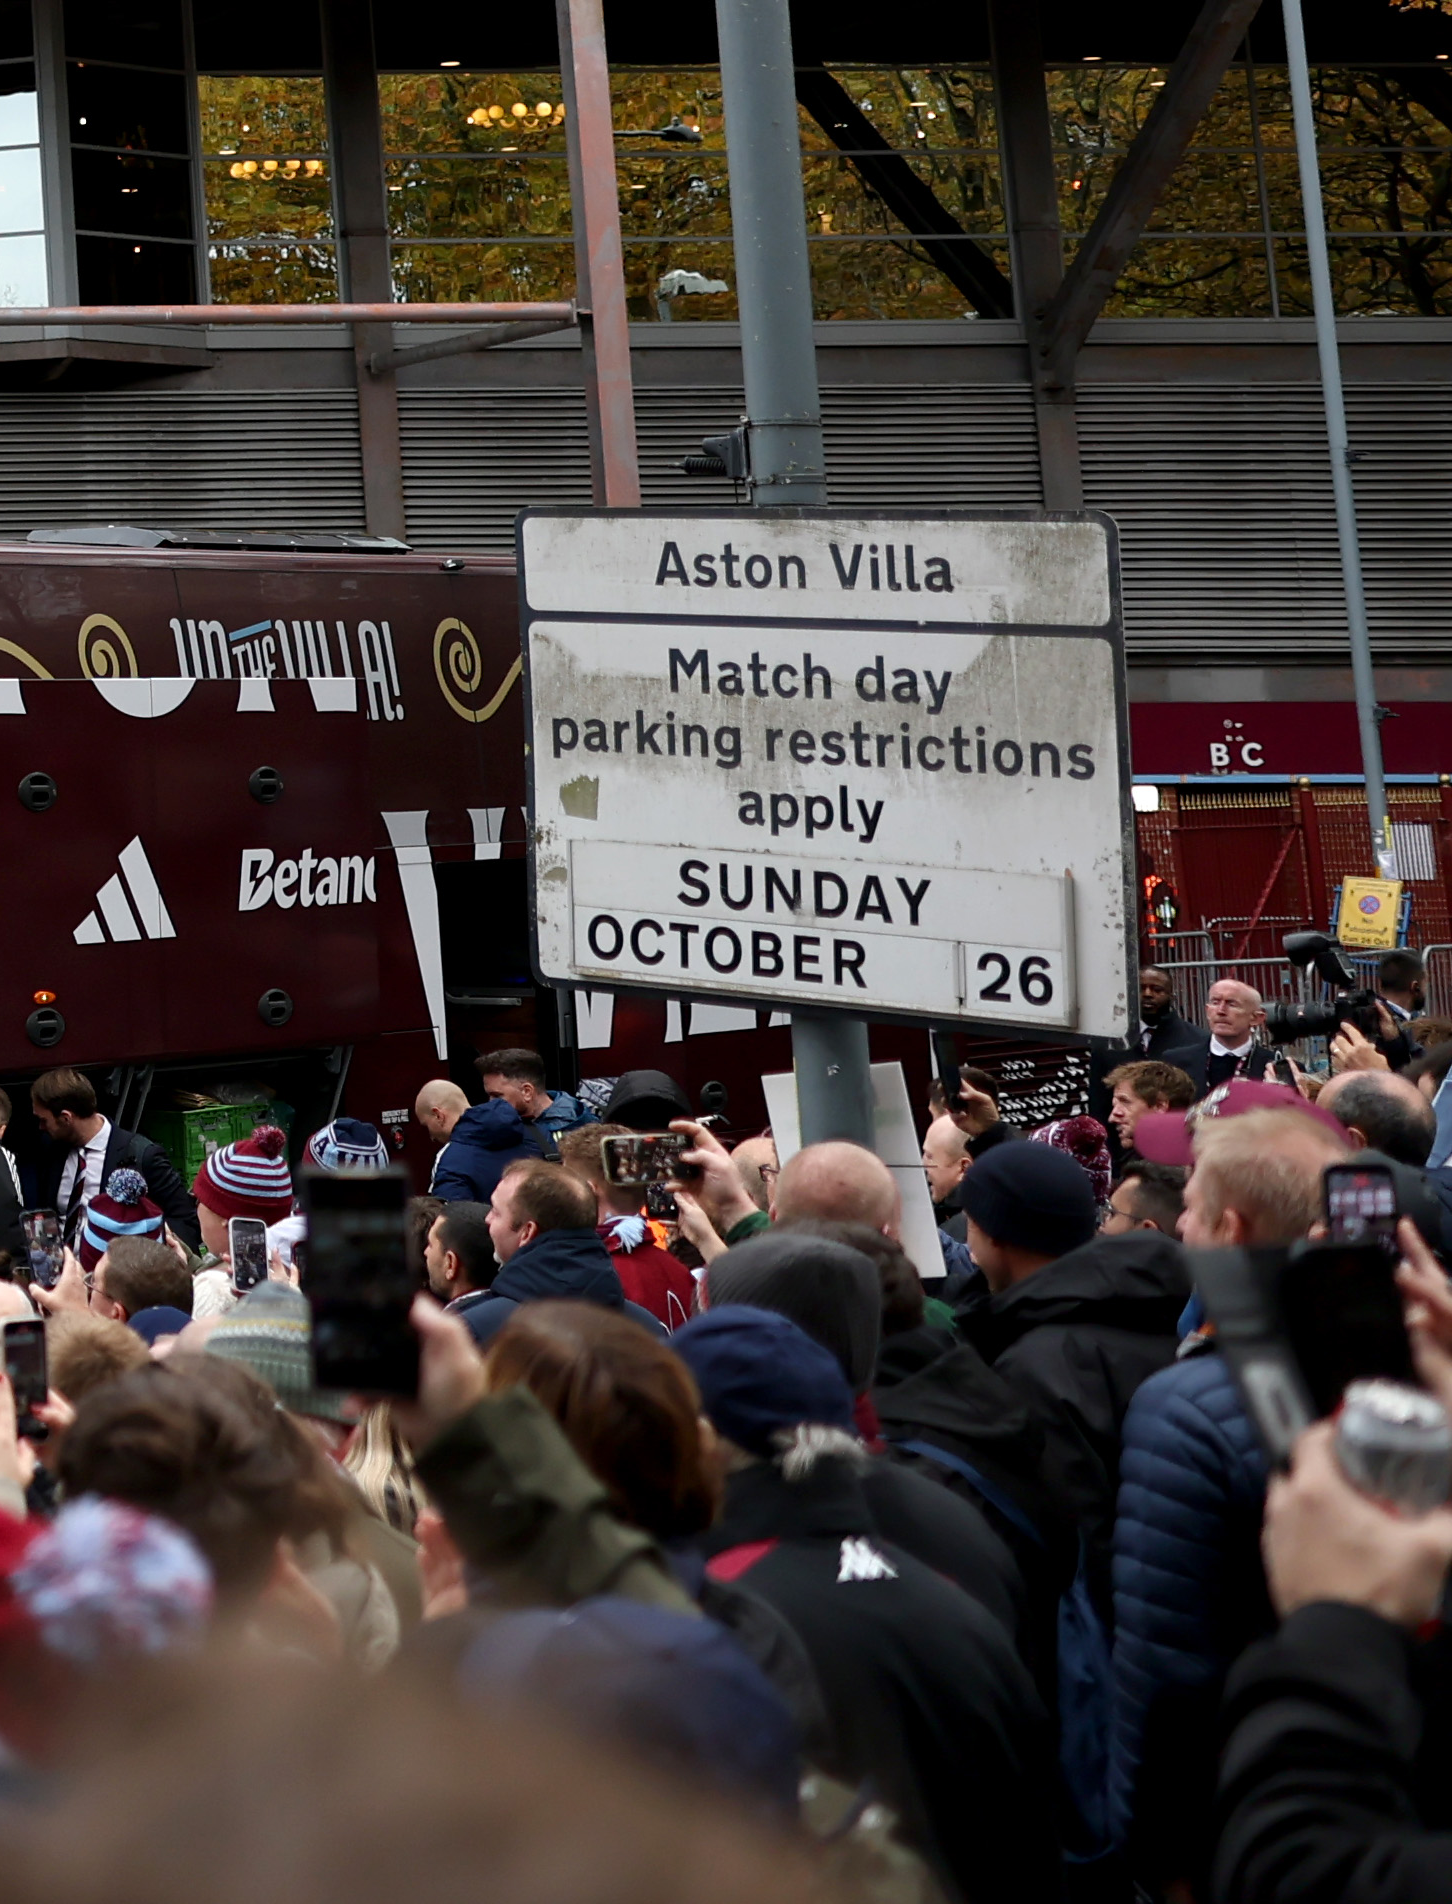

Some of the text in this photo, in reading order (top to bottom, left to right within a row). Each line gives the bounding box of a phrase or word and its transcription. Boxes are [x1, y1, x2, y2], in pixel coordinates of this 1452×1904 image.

[655, 540, 955, 594] Aston Villa
[668, 648, 953, 716] Match day
[552, 710, 1096, 781] parking restrictions
[738, 784, 885, 844] apply
[677, 859, 932, 927] SUNDAY
[587, 914, 1054, 1007] OCTOBER 26
